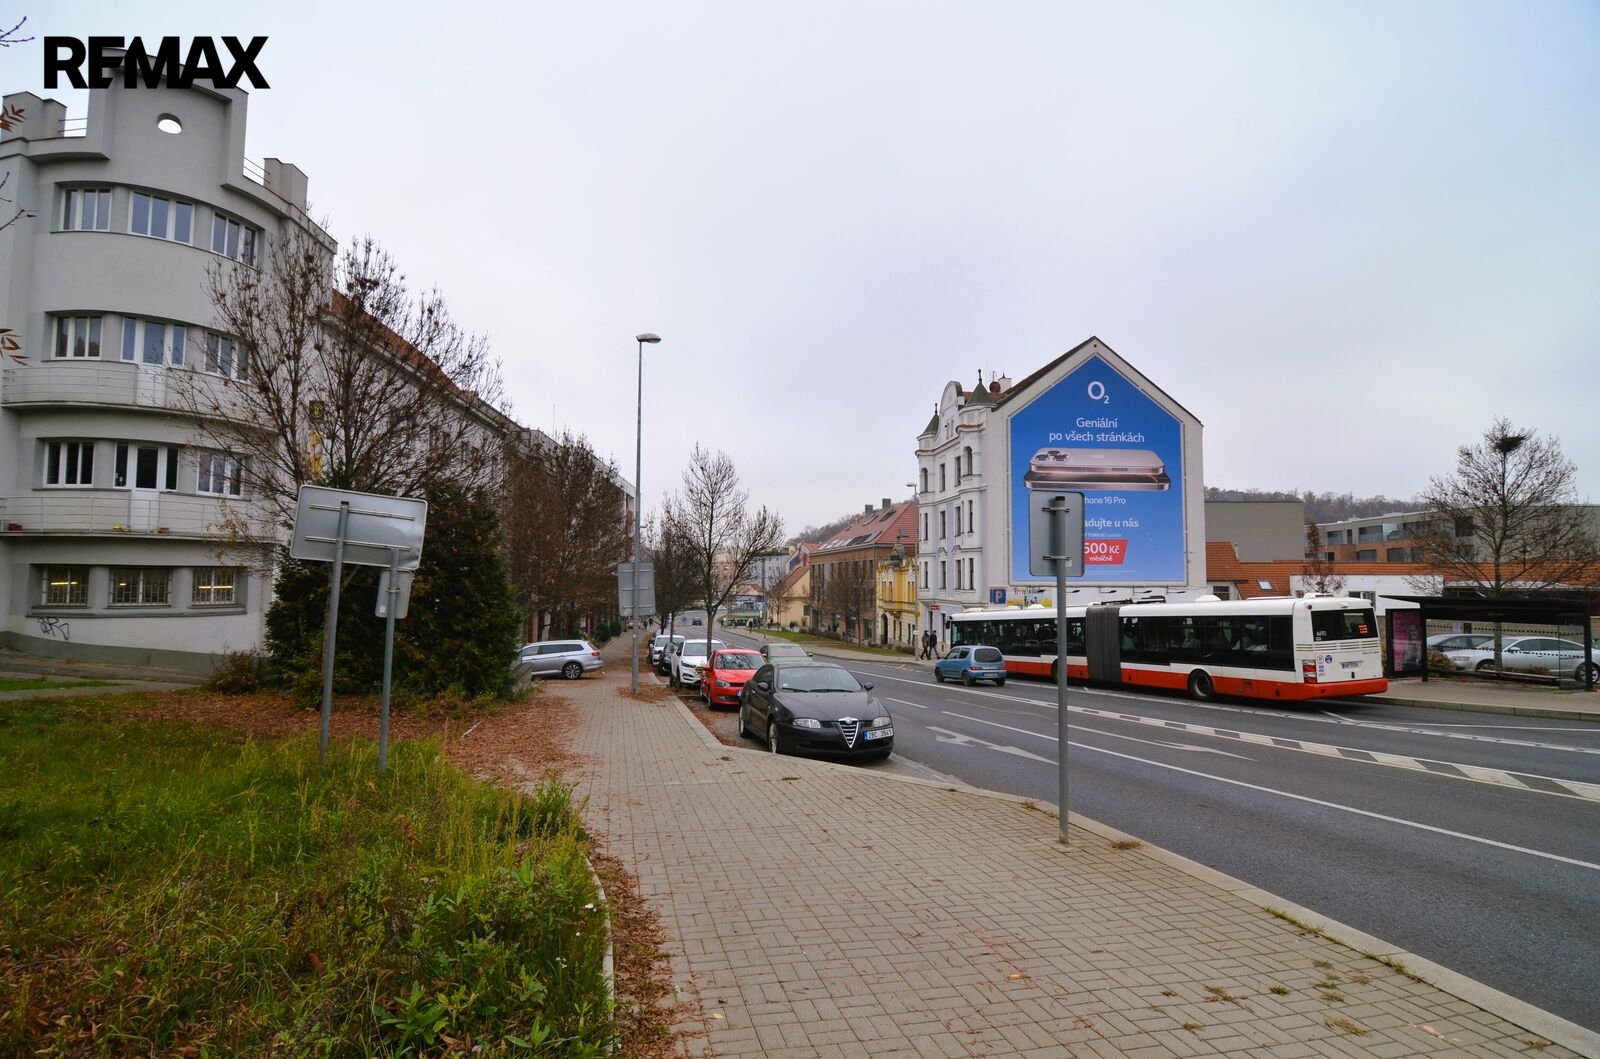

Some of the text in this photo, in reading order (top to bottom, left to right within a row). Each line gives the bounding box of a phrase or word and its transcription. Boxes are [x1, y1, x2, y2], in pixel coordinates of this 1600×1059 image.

[1087, 381, 1110, 404] O2
[1076, 417, 1118, 428] Geniální
[1049, 431, 1145, 443] po všech stránkách
[1104, 496, 1112, 504] 16
[1113, 496, 1126, 504] Pro
[1123, 518, 1139, 528] nás
[1109, 545, 1120, 554] Kč
[1089, 554, 1113, 562] měsíčně
